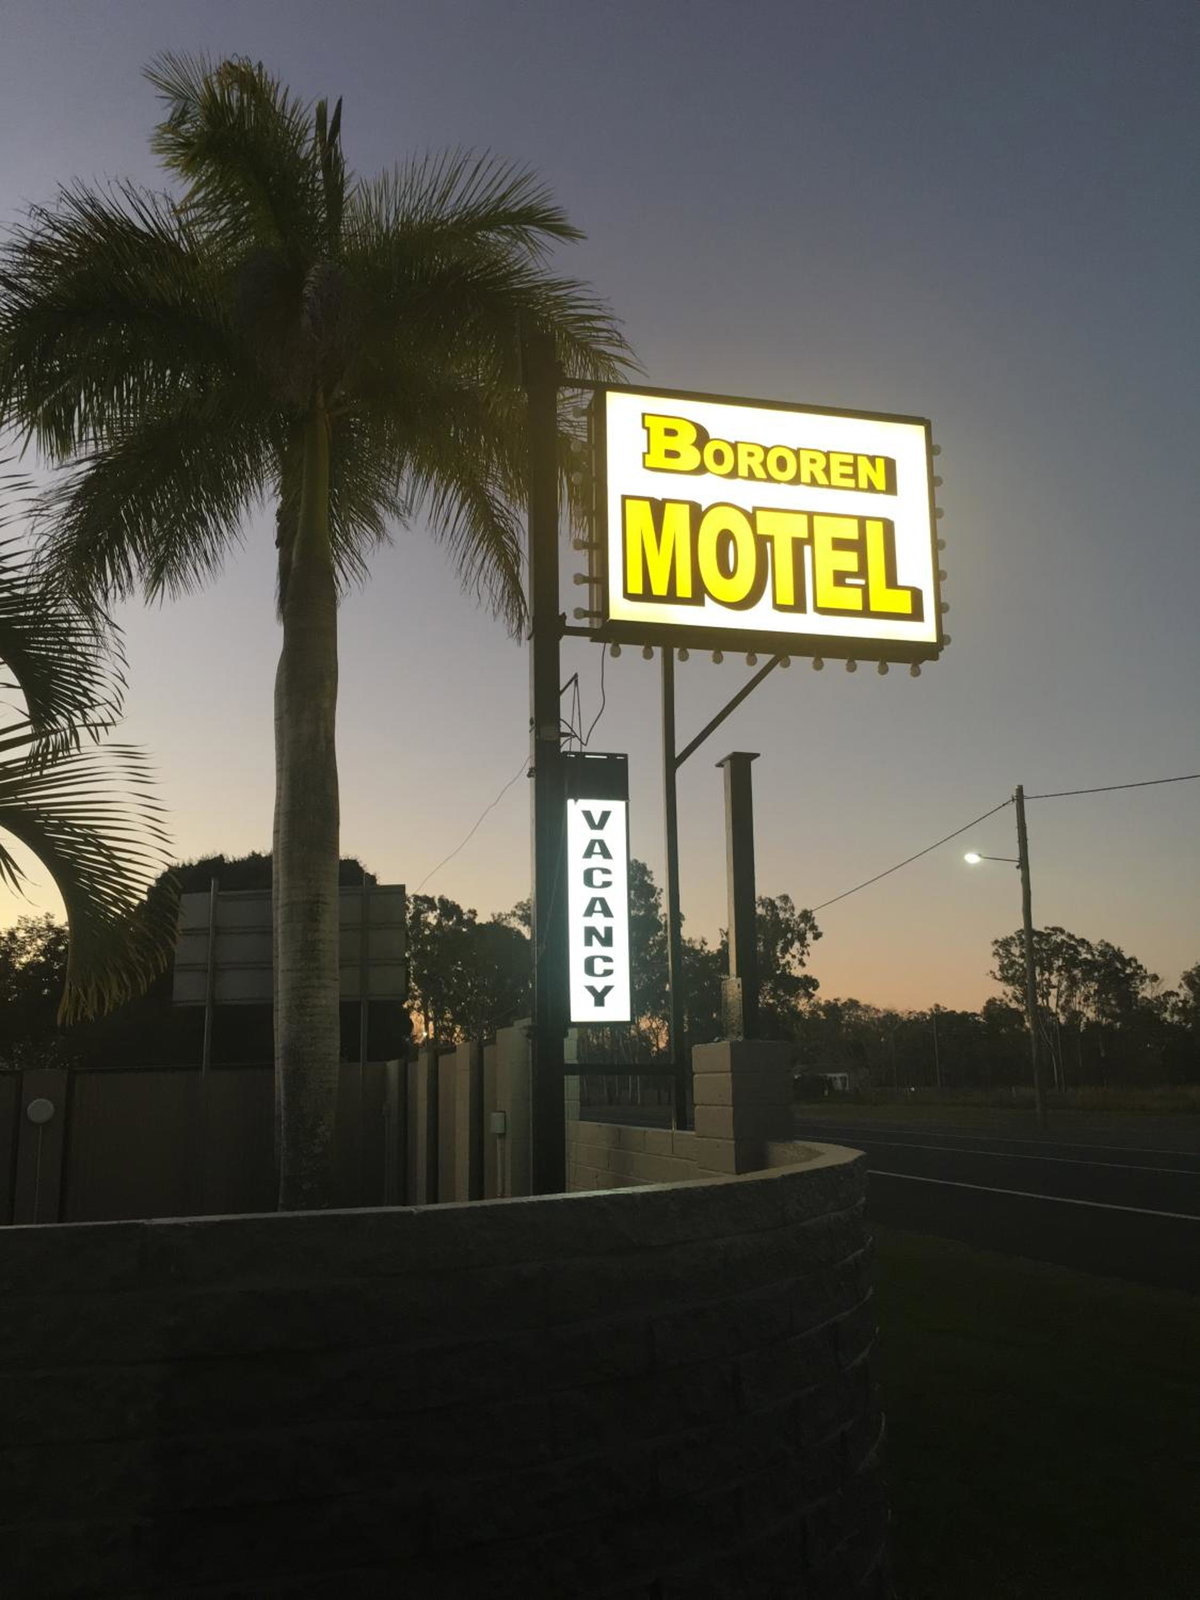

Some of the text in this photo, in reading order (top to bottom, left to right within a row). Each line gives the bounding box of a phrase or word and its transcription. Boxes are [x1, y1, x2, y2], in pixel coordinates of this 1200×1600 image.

[641, 412, 898, 496] BOROREN
[621, 494, 925, 622] MOTEL
[581, 810, 615, 1007] VACANCY
